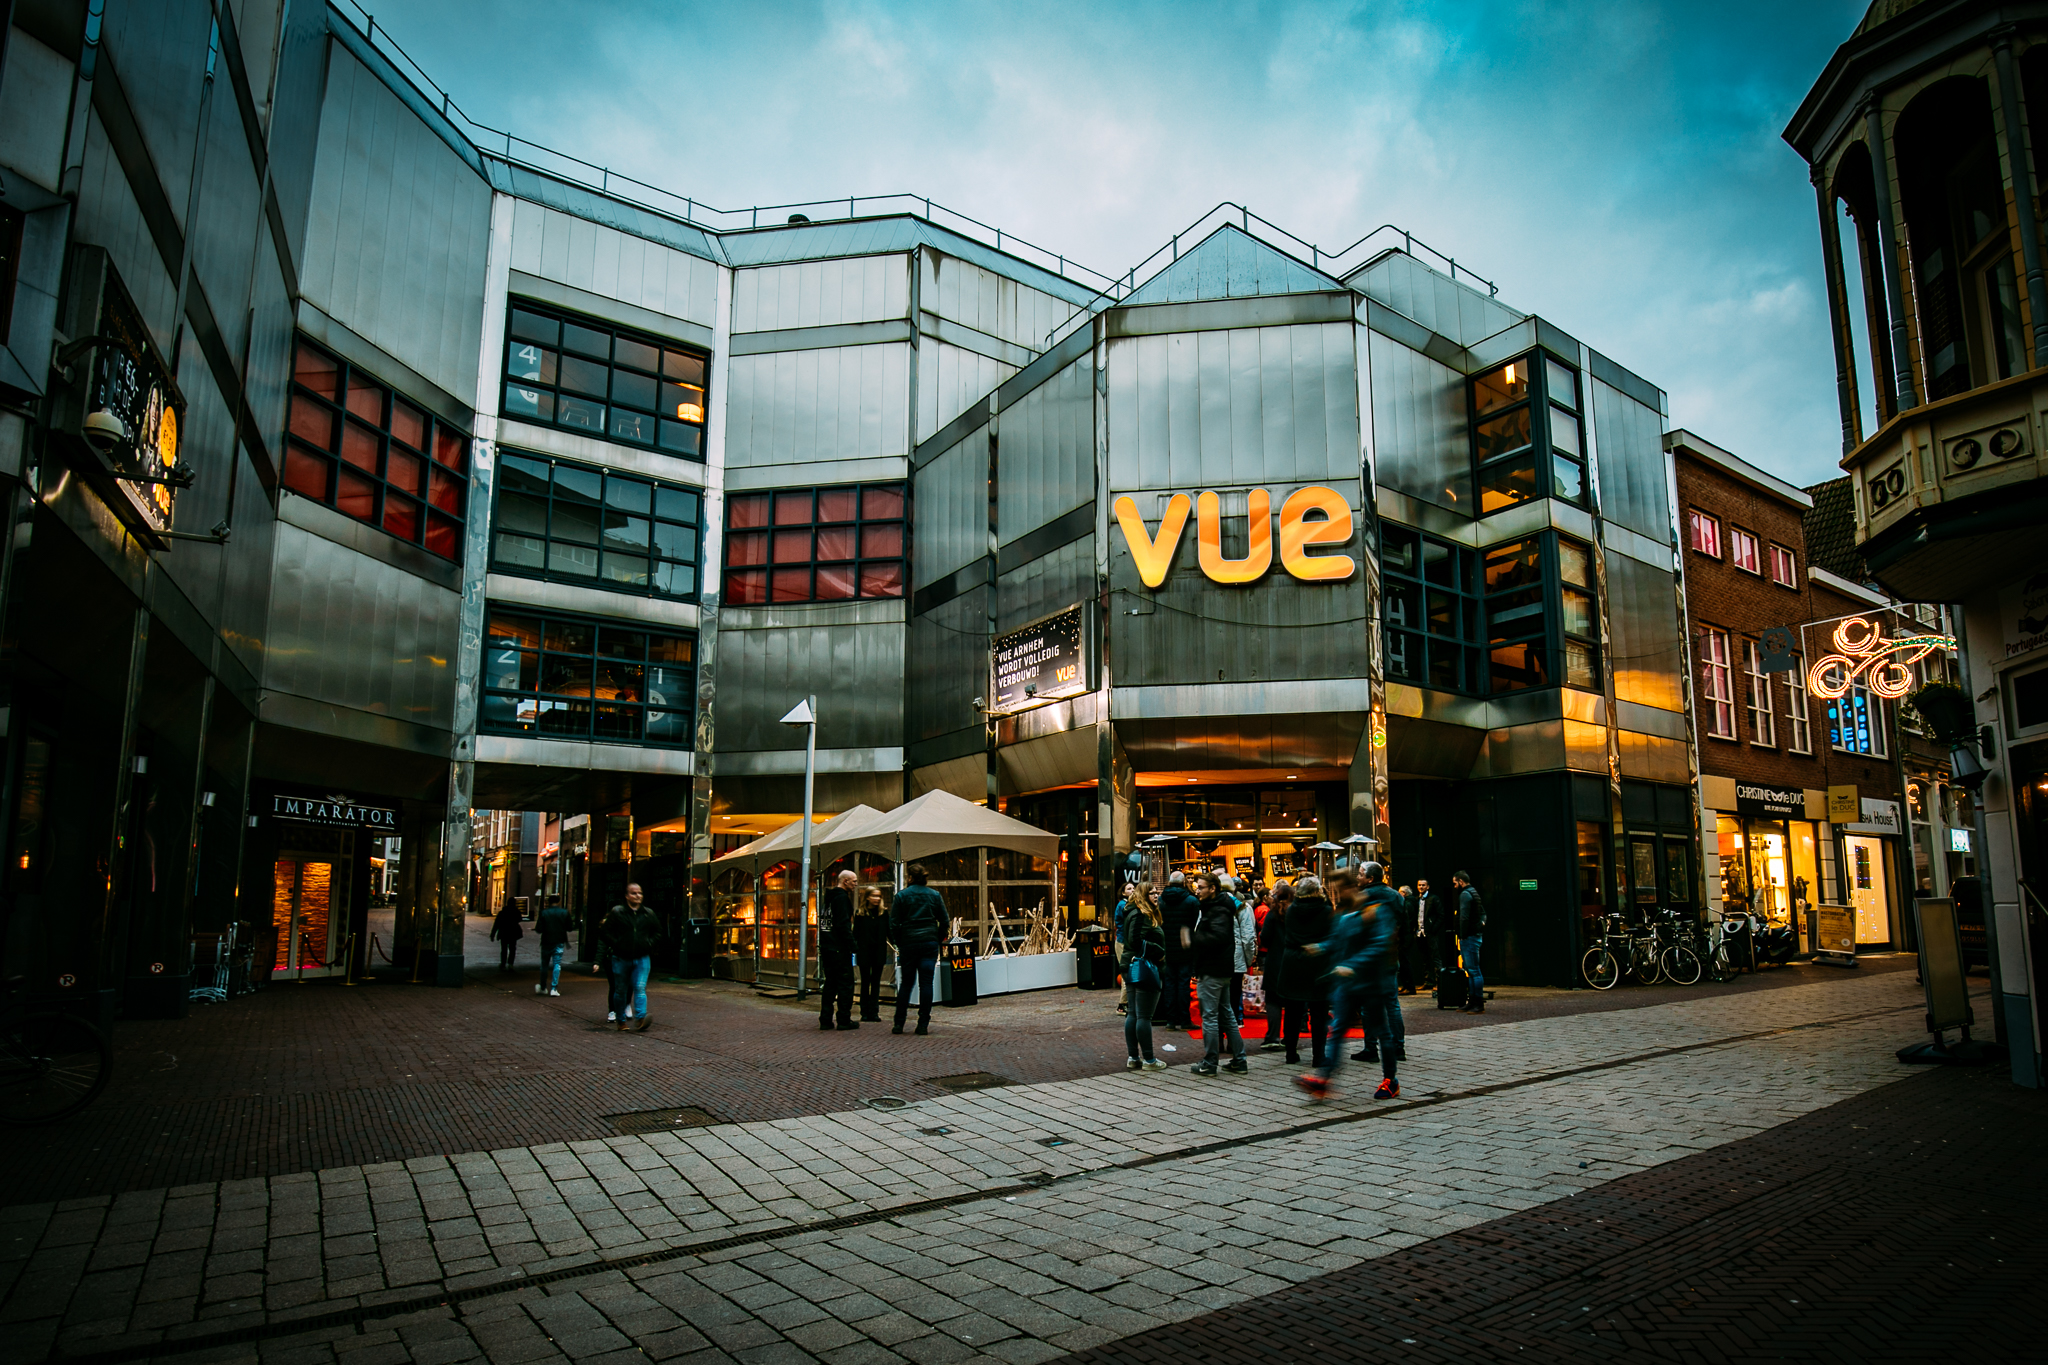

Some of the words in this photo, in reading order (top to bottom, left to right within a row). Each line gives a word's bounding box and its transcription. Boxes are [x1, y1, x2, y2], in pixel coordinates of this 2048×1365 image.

[518, 345, 536, 364] 4
[122, 388, 132, 416] DE
[497, 640, 516, 664] 2
[998, 648, 1012, 663] VUE
[1014, 637, 1044, 658] ARNHEM
[998, 658, 1022, 676] WORDT
[1024, 644, 1060, 667] VOLLEDIG
[998, 665, 1040, 689] VERBOUWD!
[1736, 785, 1772, 802] CHRISTINE
[1790, 792, 1805, 805] DUC
[274, 798, 394, 824] IMPARATOR
[1861, 814, 1873, 824] SHA
